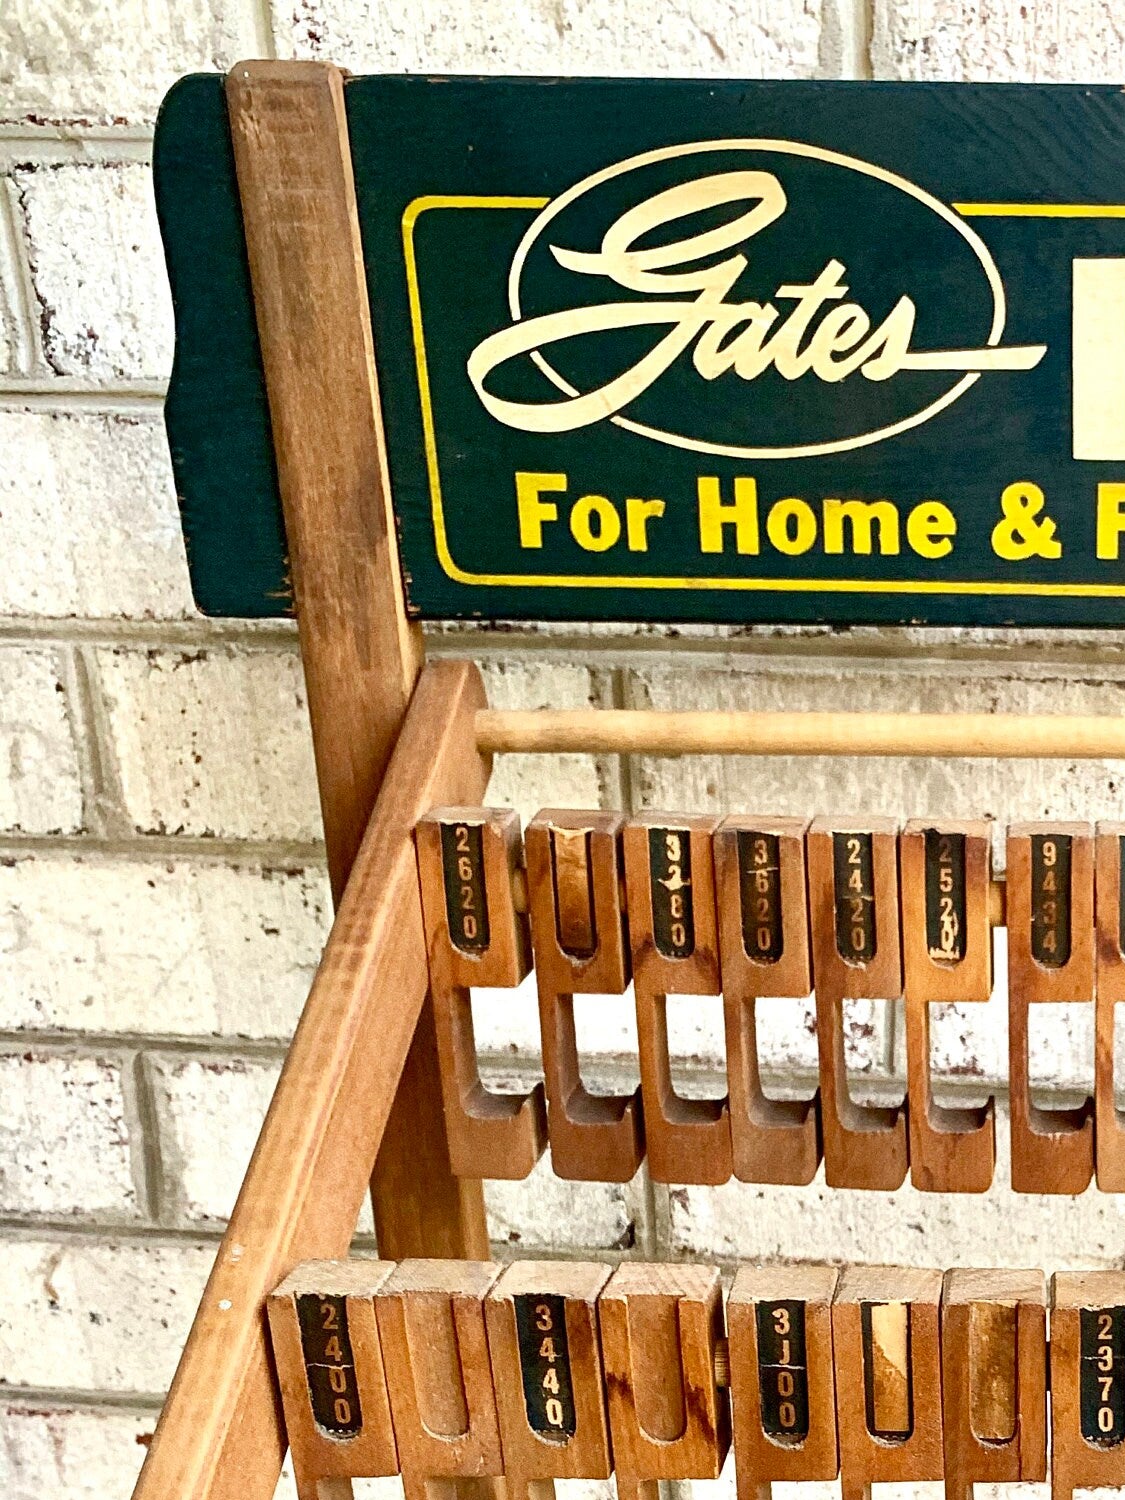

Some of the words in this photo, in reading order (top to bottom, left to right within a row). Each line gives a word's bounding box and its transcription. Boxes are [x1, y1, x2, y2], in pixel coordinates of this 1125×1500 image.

[467, 170, 1047, 433] Gates
[514, 470, 667, 550] For
[697, 476, 958, 558] Home
[990, 481, 1063, 561] &
[454, 826, 478, 939] 2620
[320, 1302, 352, 1425] 2400
[535, 1303, 564, 1428] 3440
[1097, 1313, 1115, 1433] 2370
